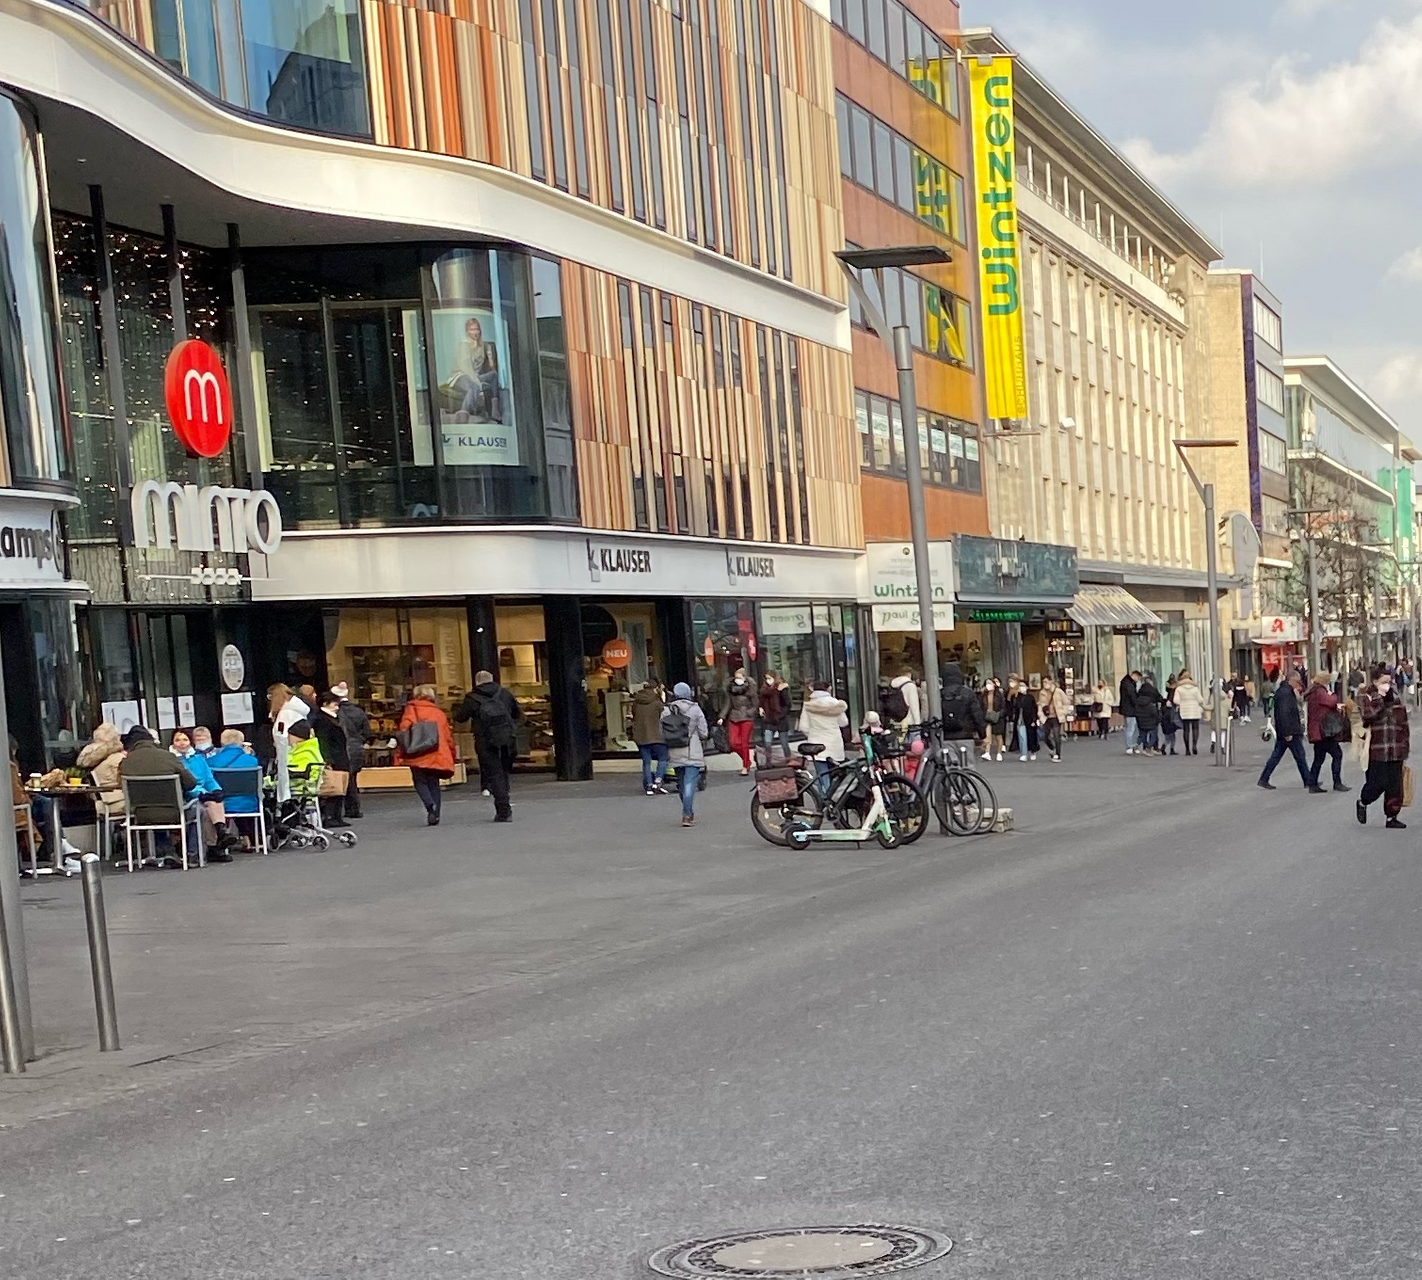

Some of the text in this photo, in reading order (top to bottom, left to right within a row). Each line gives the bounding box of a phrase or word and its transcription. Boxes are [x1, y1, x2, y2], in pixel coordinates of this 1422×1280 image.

[982, 75, 1019, 317] Wintzen
[0, 526, 53, 570] amps
[601, 548, 652, 573] KLAUSER
[736, 556, 776, 578] KLAUSER
[881, 609, 909, 626] paul
[605, 649, 628, 658] NEU
